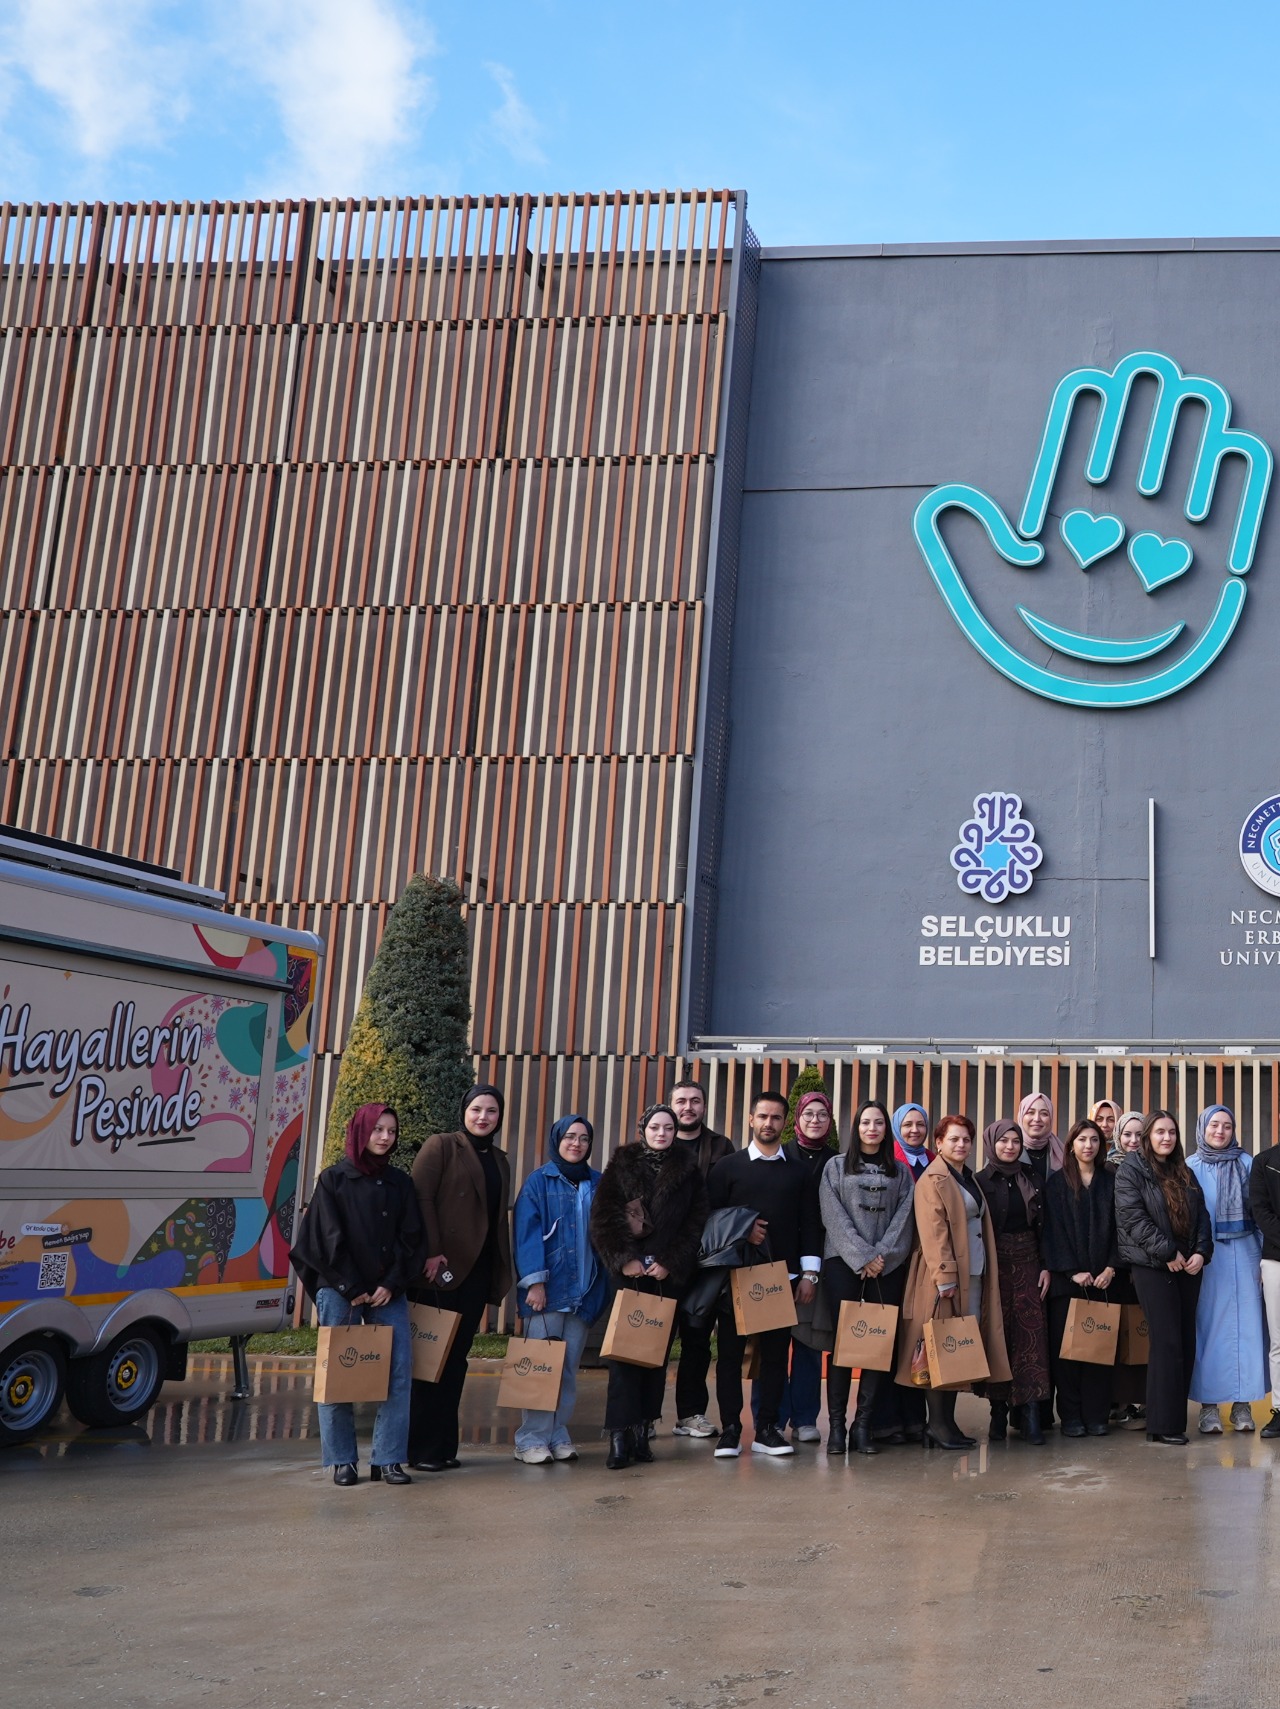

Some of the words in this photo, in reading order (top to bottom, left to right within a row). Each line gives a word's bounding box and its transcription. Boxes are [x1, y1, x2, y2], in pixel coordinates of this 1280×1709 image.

[920, 915, 1071, 943] SELÇUKLU
[919, 941, 1070, 966] BELEDİYESİ
[0, 1001, 202, 1098] Hayallerin
[71, 1067, 201, 1153] Peşinde
[765, 1284, 783, 1294] sobe
[645, 1317, 664, 1328] sobe
[1096, 1323, 1112, 1331] sobe
[868, 1326, 887, 1335] sobe
[418, 1331, 438, 1341] sobe
[957, 1337, 974, 1346] sobe
[360, 1351, 380, 1361] sobe
[533, 1364, 552, 1373] sobe
